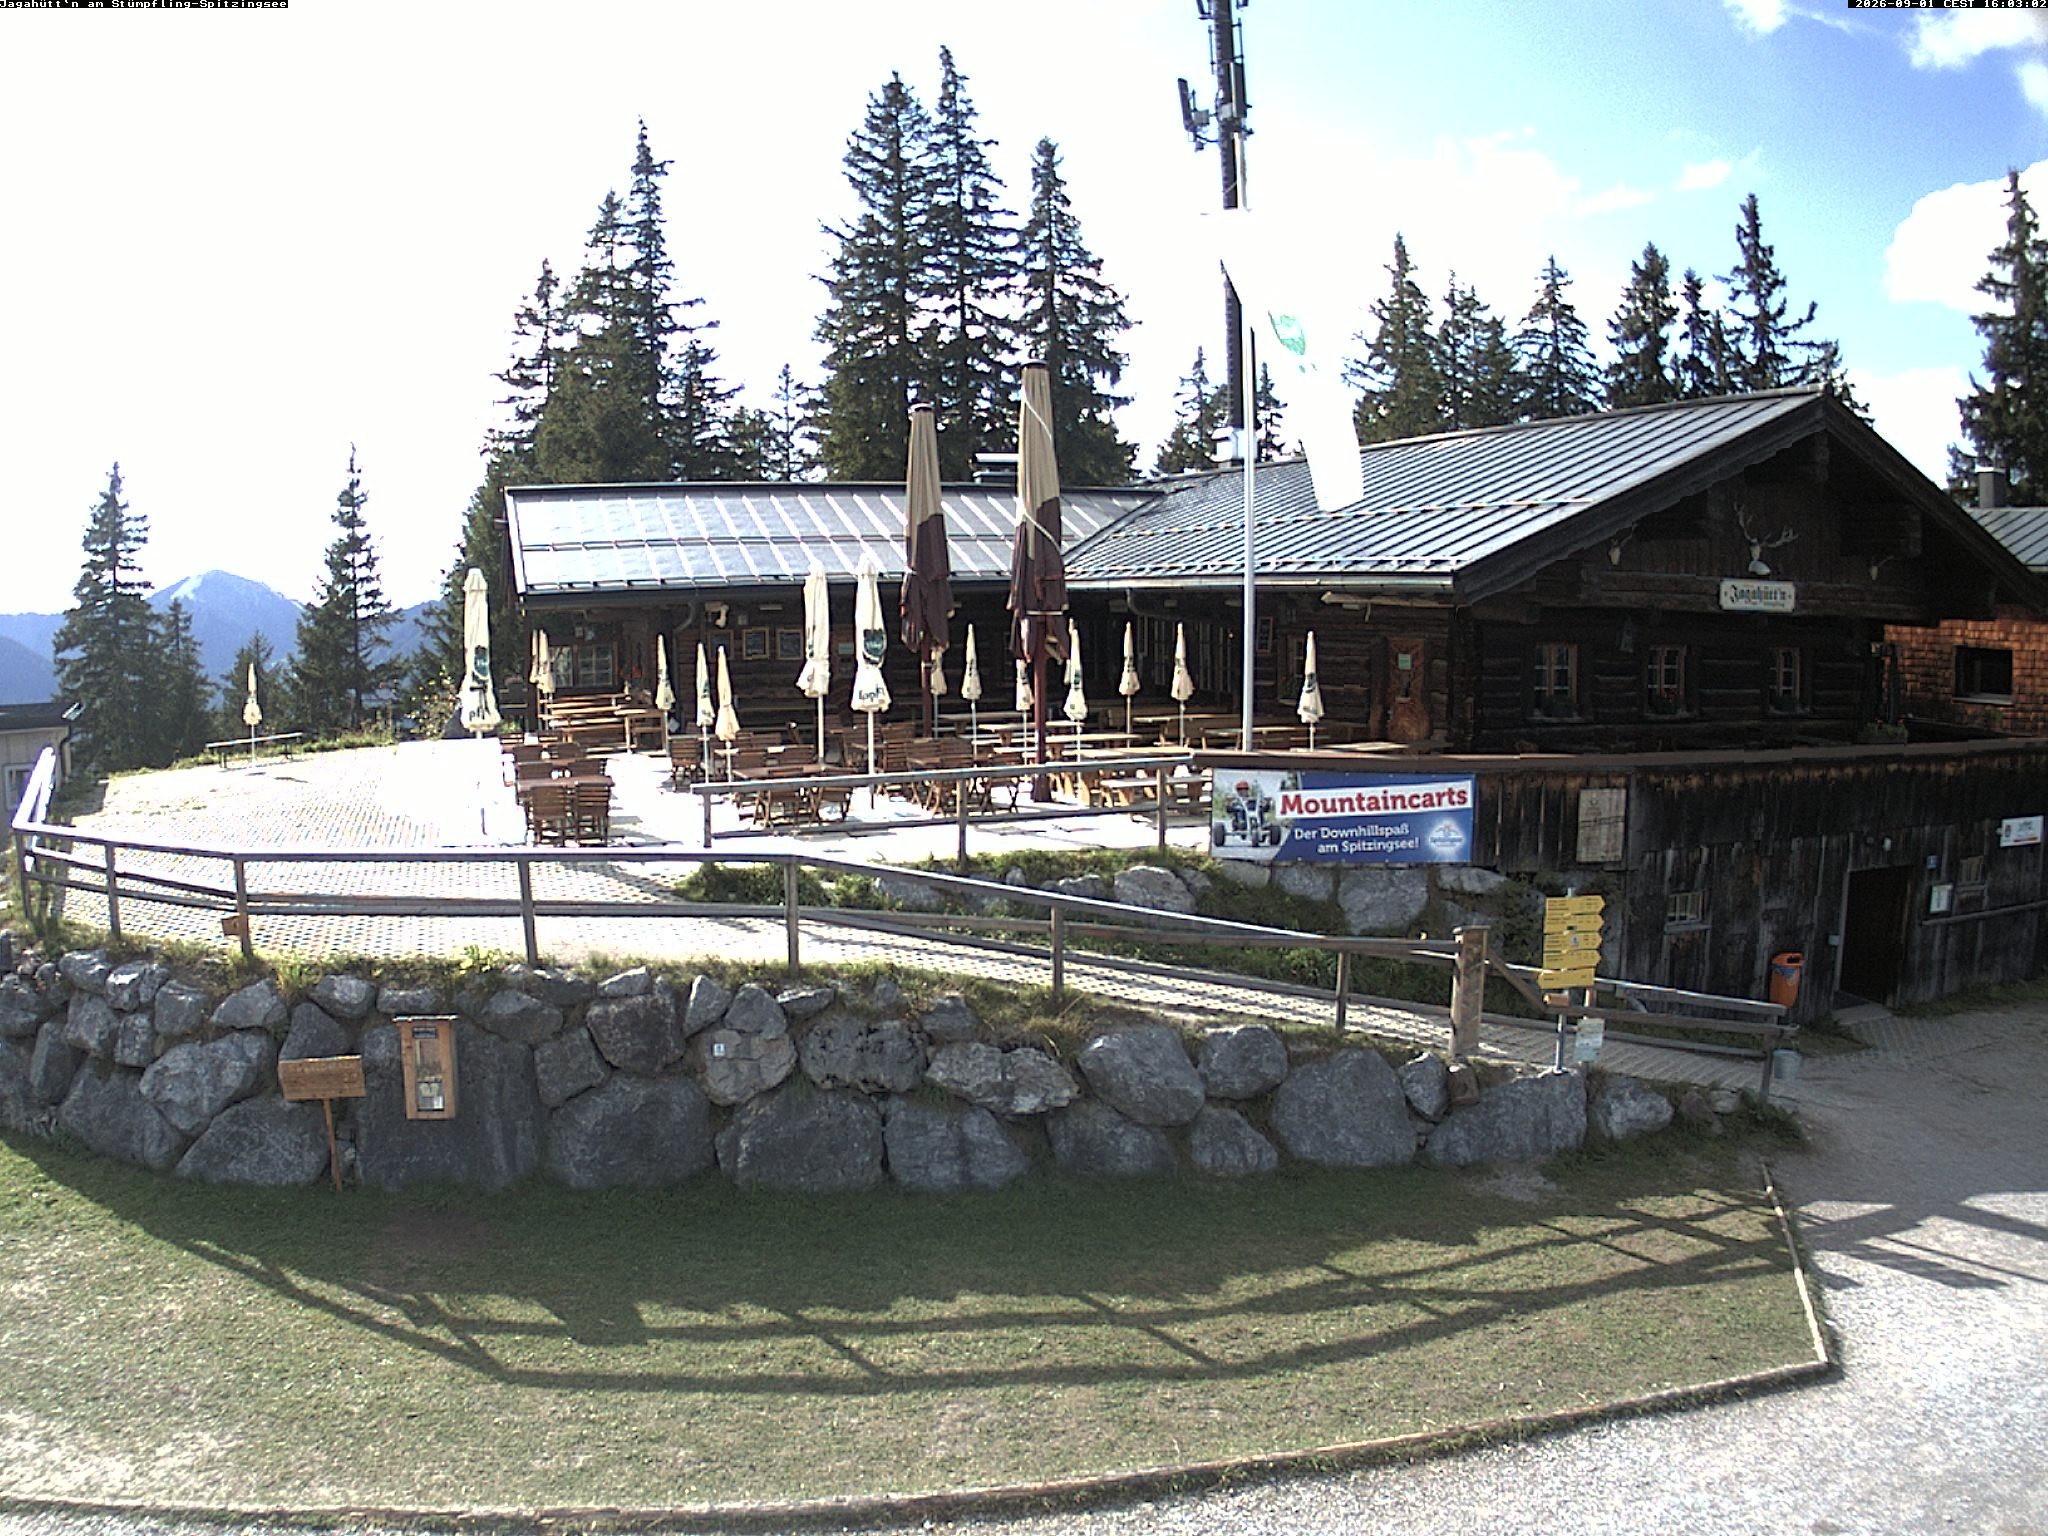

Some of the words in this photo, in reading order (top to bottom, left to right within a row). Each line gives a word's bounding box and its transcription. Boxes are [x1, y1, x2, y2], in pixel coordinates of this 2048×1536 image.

[1280, 787, 1468, 815] Mountaincarts
[1294, 828, 1317, 840] Der
[1320, 822, 1410, 838] Downhillspaß
[1317, 843, 1339, 853] am
[1341, 837, 1420, 854] Spitzingsee!
